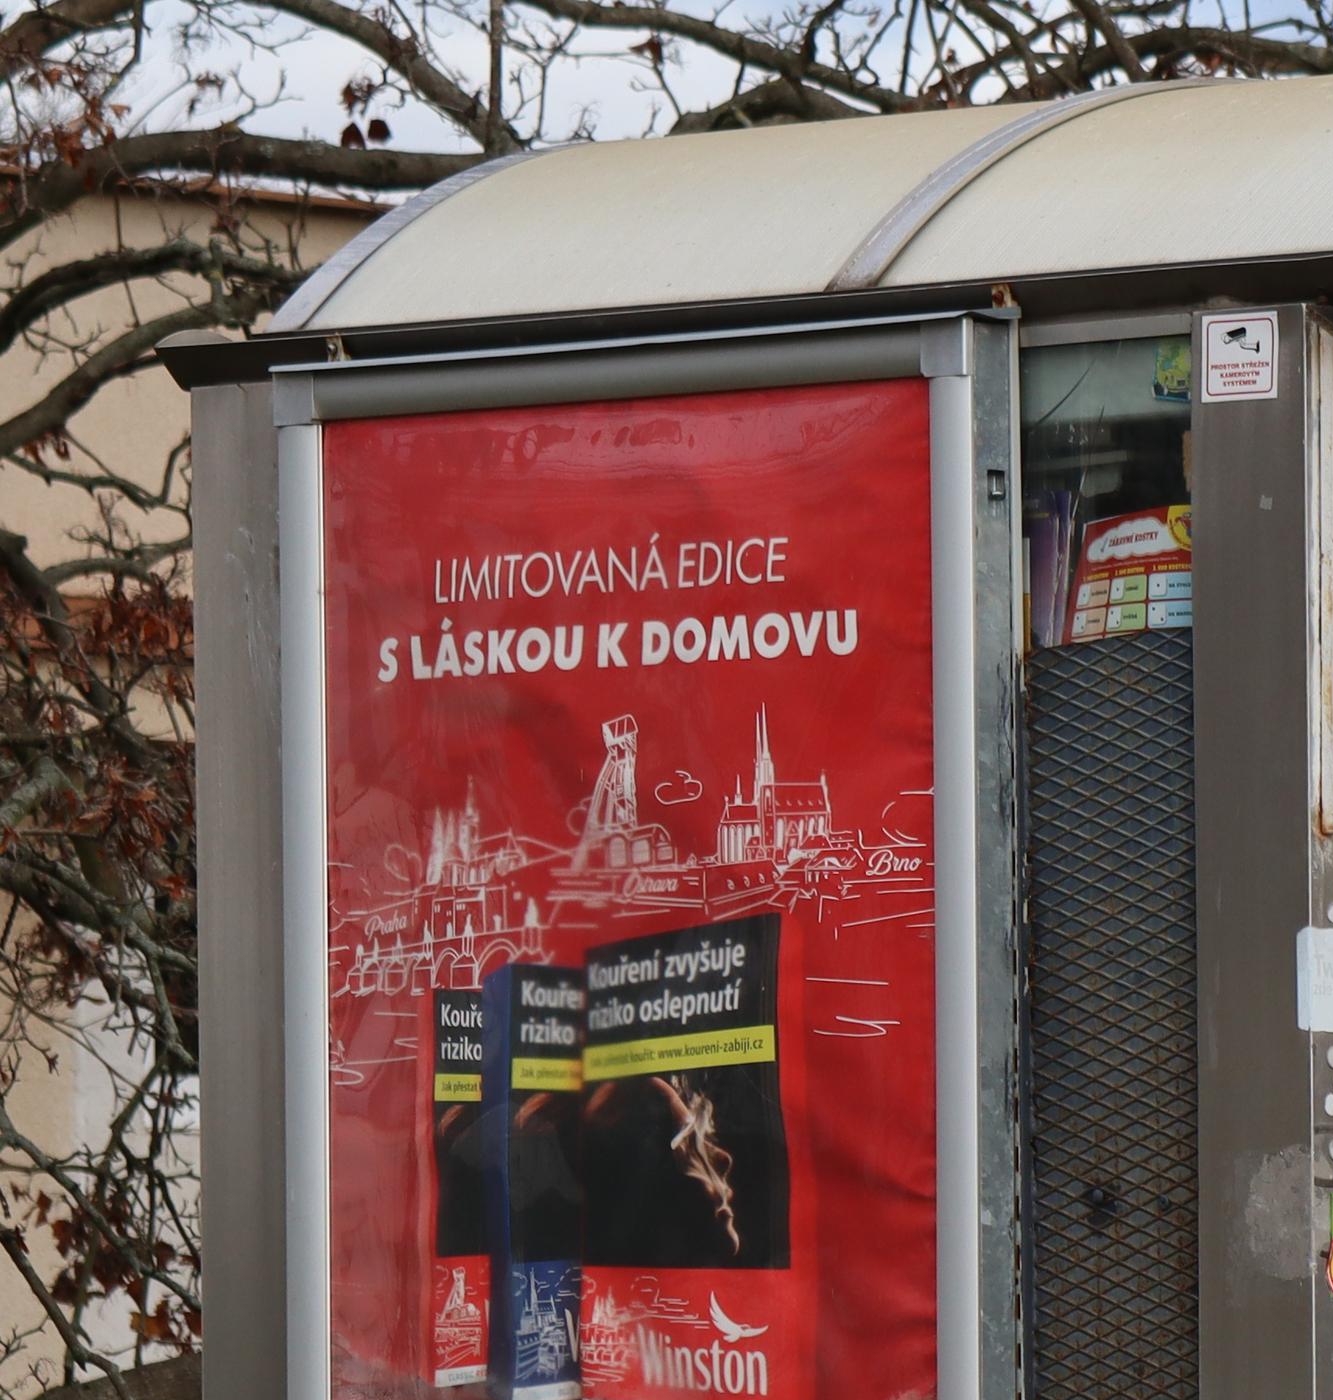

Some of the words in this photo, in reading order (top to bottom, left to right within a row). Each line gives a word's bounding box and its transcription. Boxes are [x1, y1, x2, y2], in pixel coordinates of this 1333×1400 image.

[433, 534, 668, 605] LIMITOVANÁ
[678, 537, 789, 590] EDICE
[378, 637, 399, 683] S
[411, 617, 583, 680] LÁSKOU
[597, 624, 628, 669] K
[641, 607, 858, 666] DOMOVU
[867, 849, 921, 878] Brno
[623, 872, 679, 898] Ostrava
[365, 913, 409, 938] Praha
[588, 950, 660, 991] Kouření
[665, 938, 747, 983] zvyšuje
[588, 999, 634, 1031] riziko
[639, 978, 743, 1026] oslepnutí
[521, 1019, 575, 1045] riziko
[657, 1036, 764, 1060] www.koureni-zabiji.cz
[637, 1322, 768, 1396] Winston
